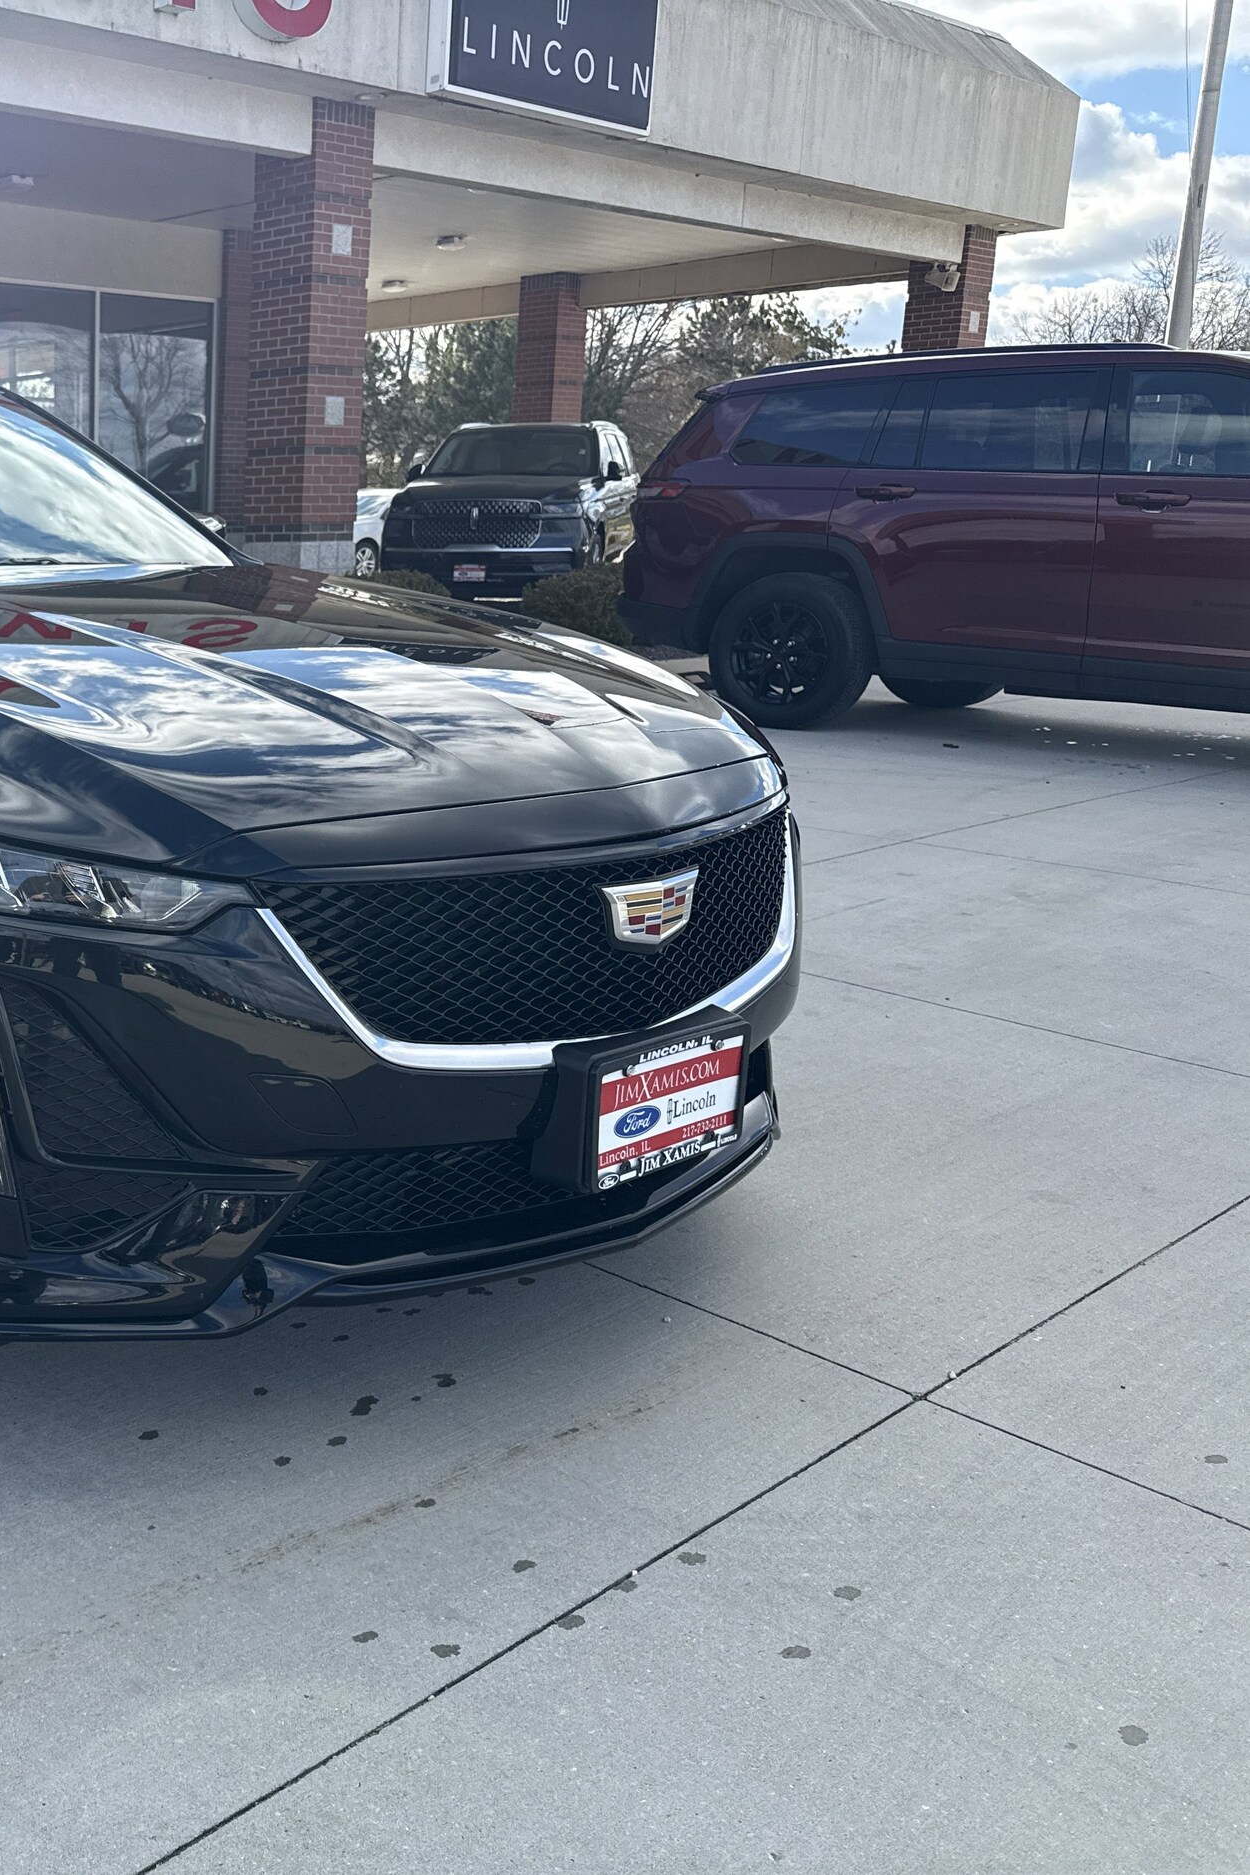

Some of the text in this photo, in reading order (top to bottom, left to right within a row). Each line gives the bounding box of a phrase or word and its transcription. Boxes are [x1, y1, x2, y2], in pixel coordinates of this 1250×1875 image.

[463, 16, 650, 98] LINCOLN
[639, 1035, 713, 1063] LINCOLN, IL
[613, 1058, 720, 1111] JIMXAMIS.COM
[673, 1091, 717, 1118] Lincoln
[623, 1110, 652, 1133] Ford
[682, 1114, 727, 1139] 217-732-2111
[638, 1141, 701, 1177] JIM XAMIS
[641, 1140, 651, 1153] IL
